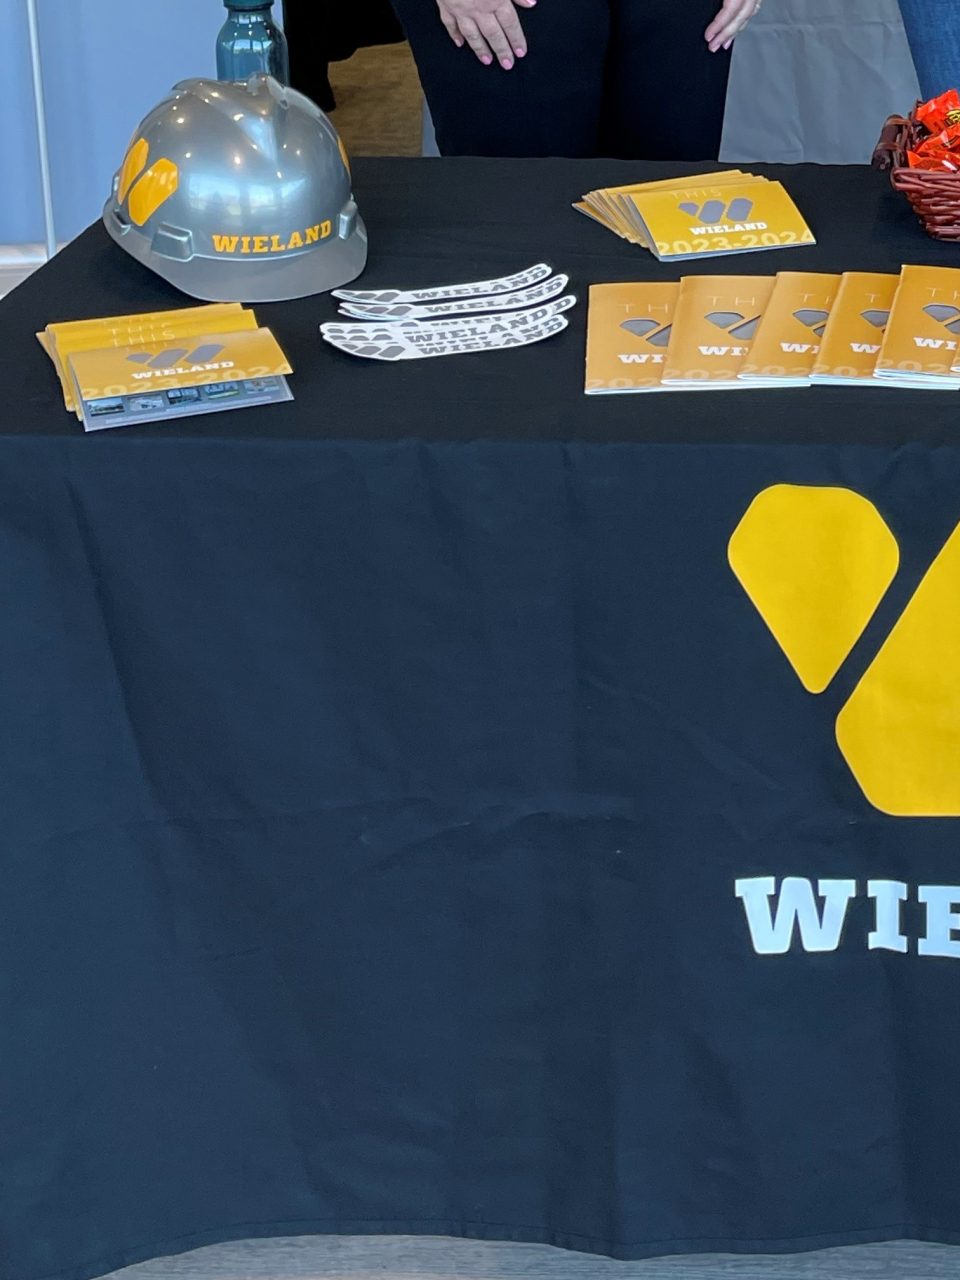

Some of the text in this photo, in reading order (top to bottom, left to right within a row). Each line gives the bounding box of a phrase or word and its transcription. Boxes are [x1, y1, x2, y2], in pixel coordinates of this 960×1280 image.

[671, 188, 722, 200] THIS
[212, 220, 332, 254] WIELAND
[689, 222, 768, 236] WIELAND
[412, 265, 548, 299] WIELAND
[424, 280, 563, 313] WIELAND
[405, 308, 548, 343] WIELAND
[419, 321, 563, 355] WIELAND
[131, 361, 235, 381] WIELAND
